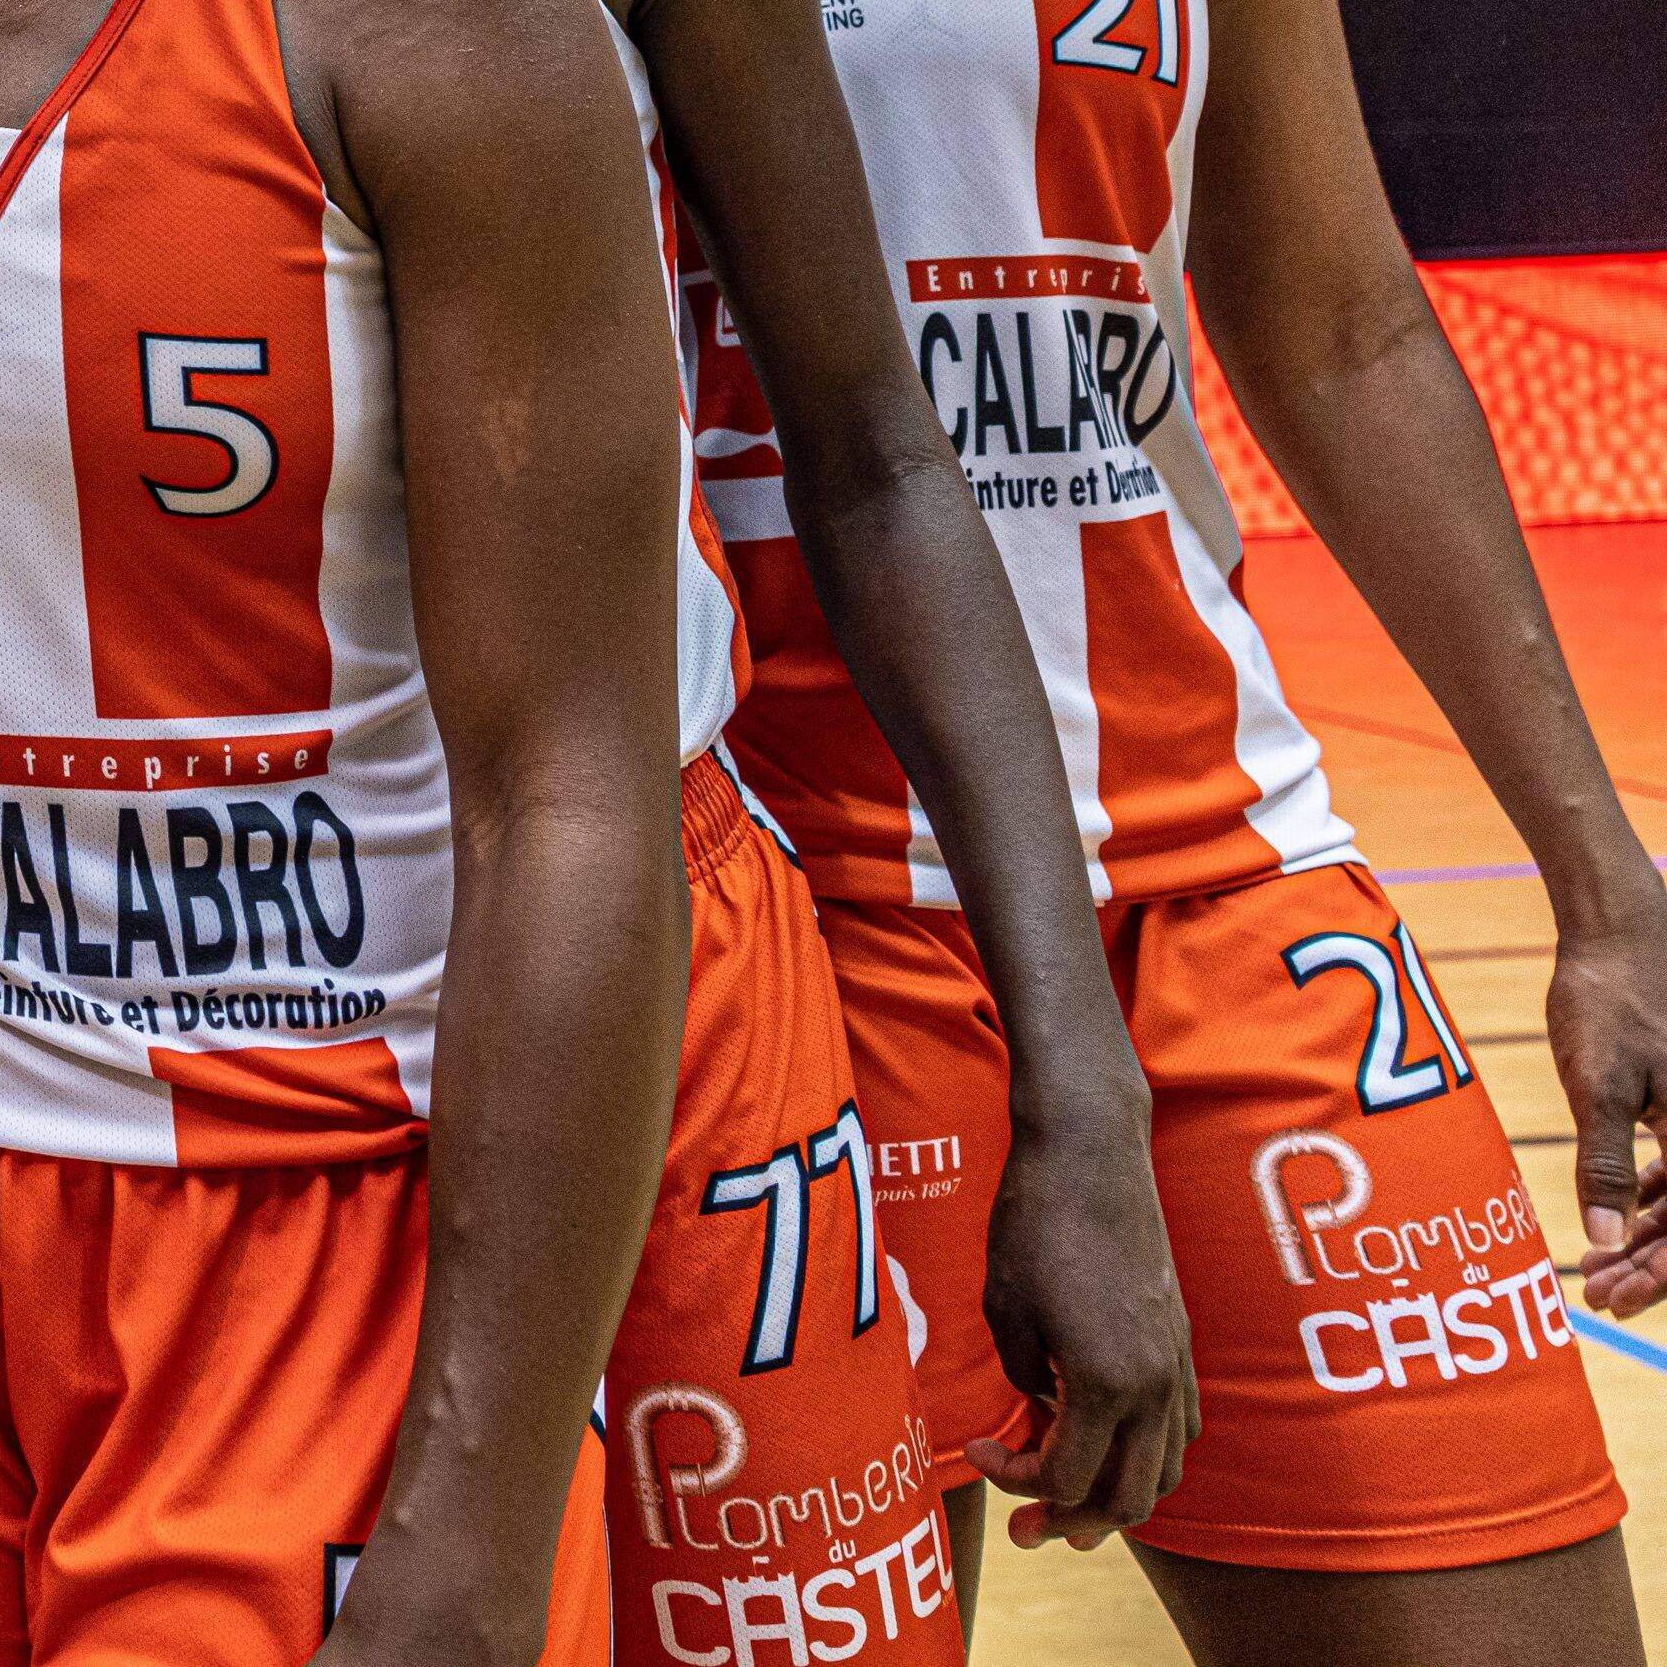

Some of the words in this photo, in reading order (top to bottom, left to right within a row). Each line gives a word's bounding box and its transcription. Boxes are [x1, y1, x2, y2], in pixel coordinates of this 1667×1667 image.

[139, 332, 281, 518] 5
[1069, 467, 1098, 507] et
[121, 994, 161, 1034] et
[172, 977, 387, 1033] Décoration
[1280, 921, 1475, 1117] 21
[921, 1178, 962, 1200] 1897
[699, 1098, 879, 1378] 77
[1462, 1263, 1491, 1286] du
[828, 1539, 857, 1564] du
